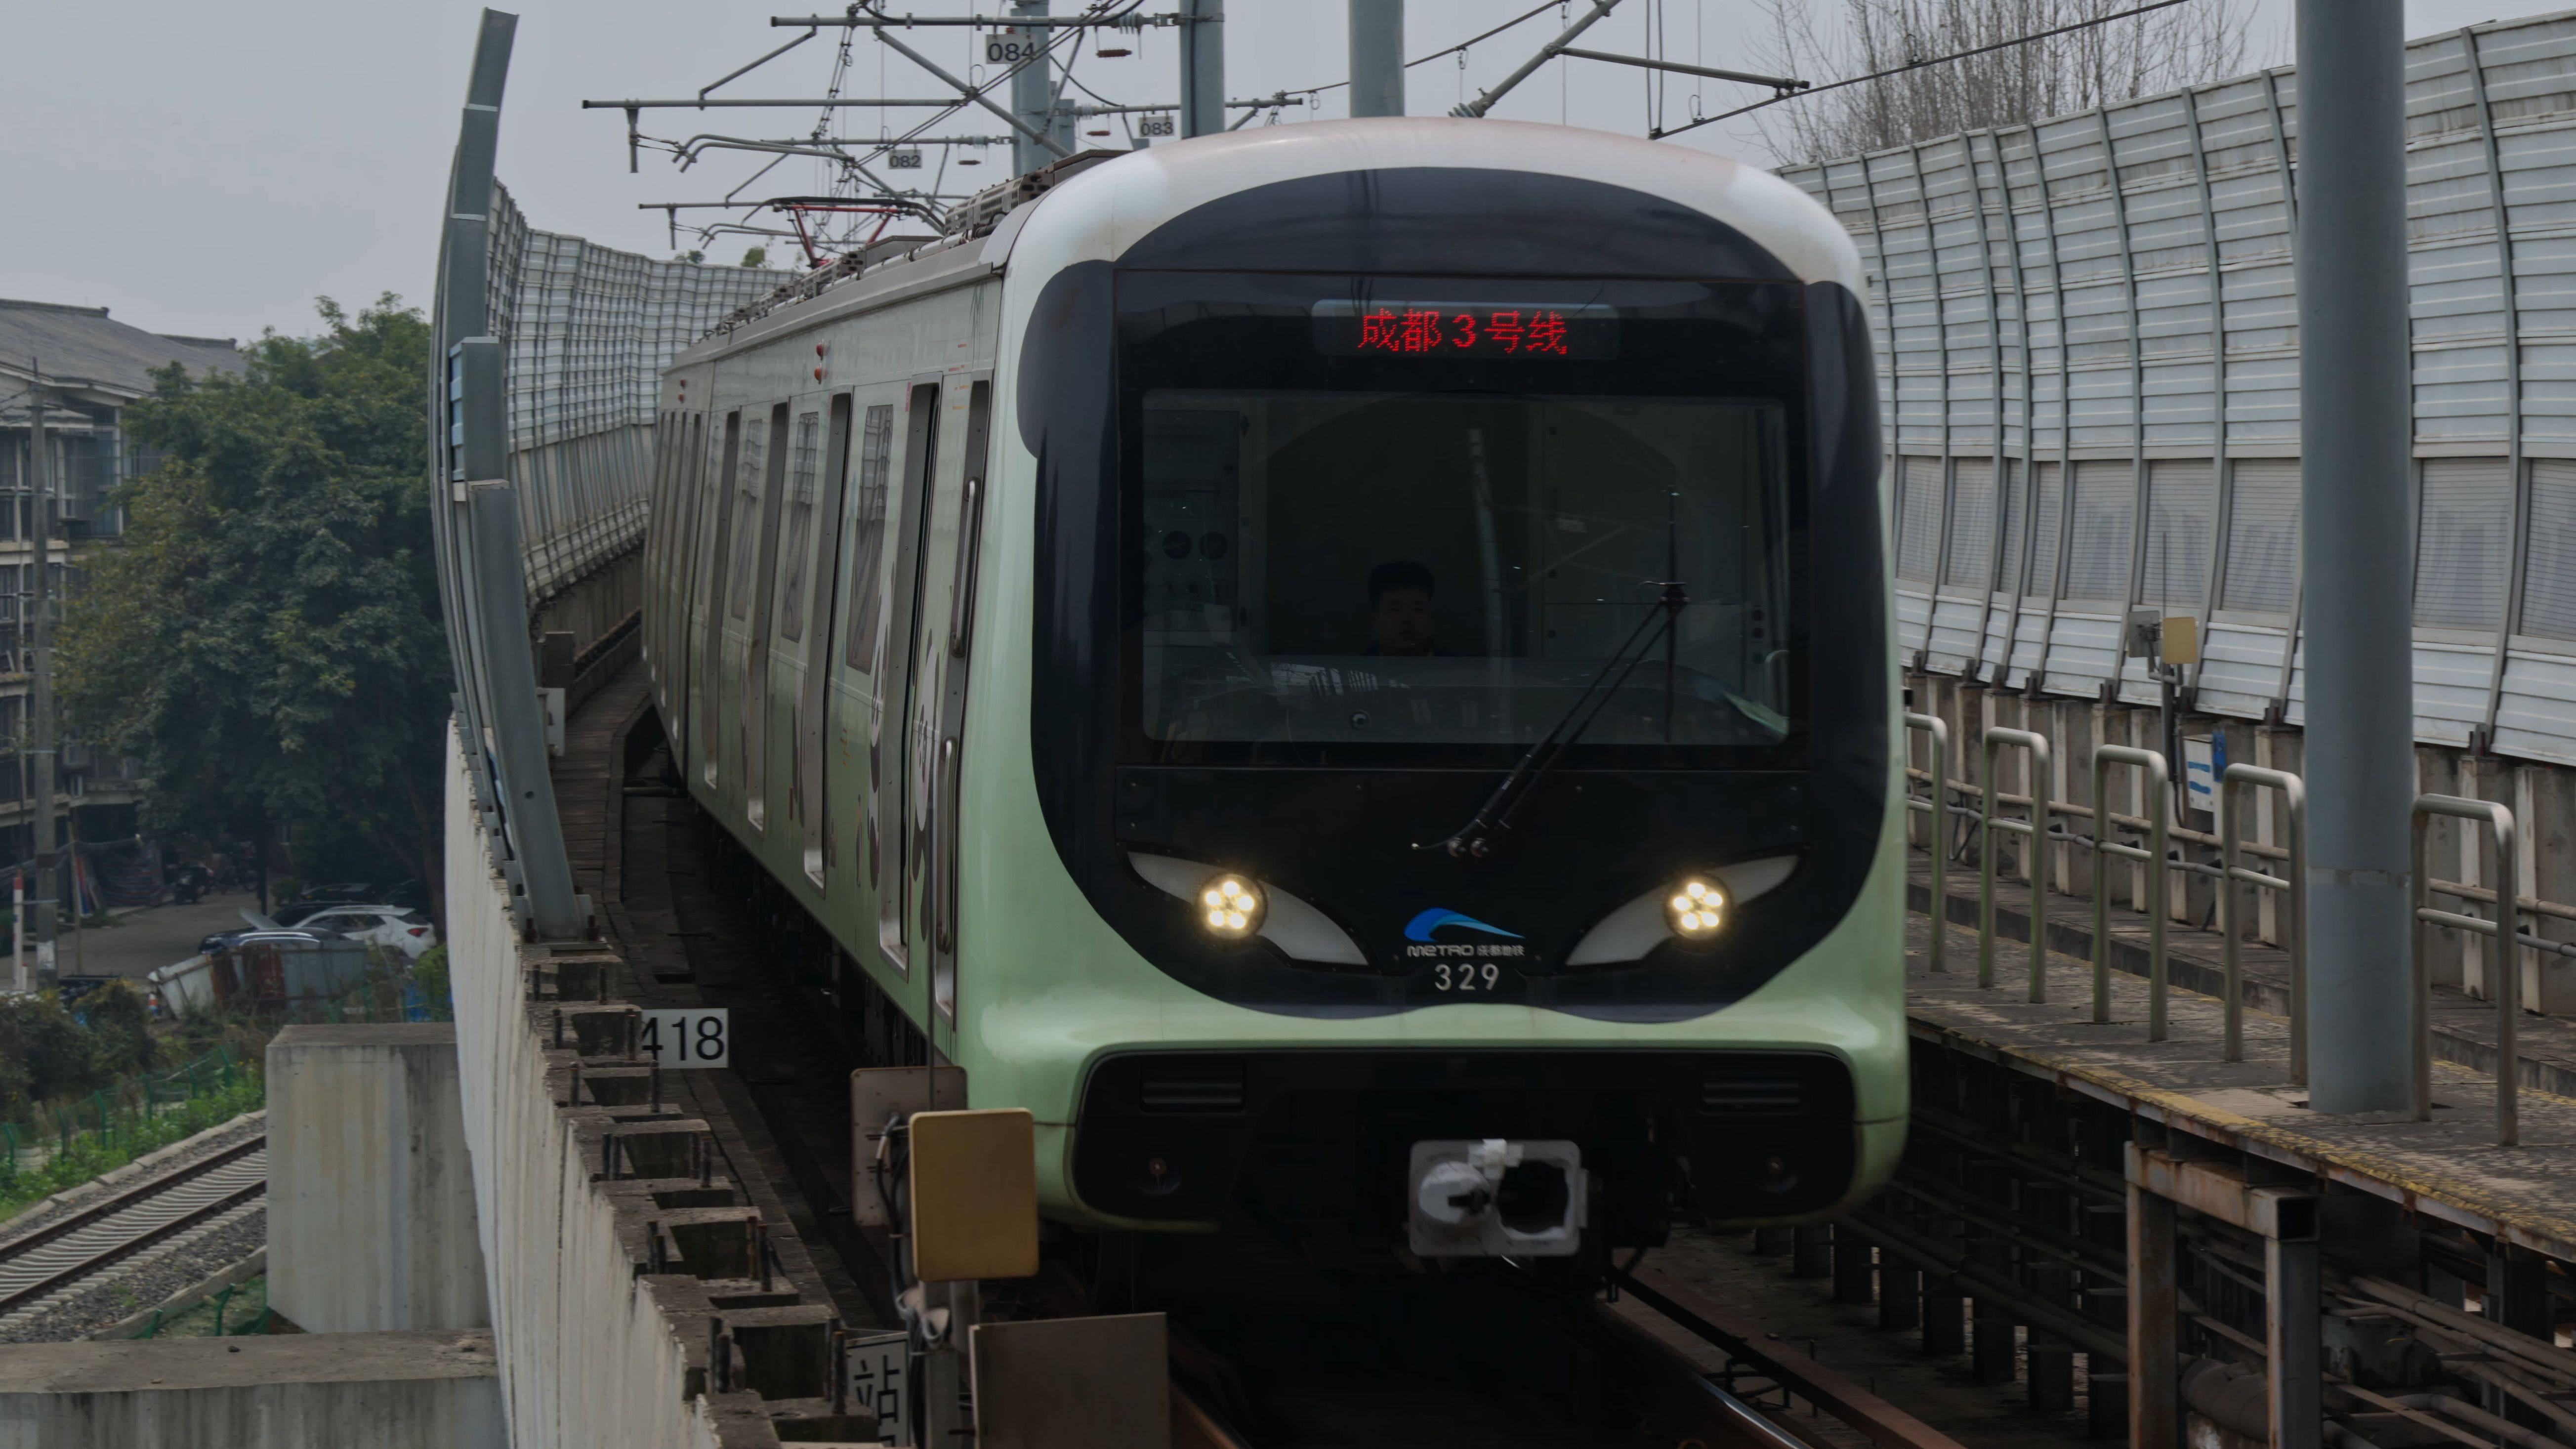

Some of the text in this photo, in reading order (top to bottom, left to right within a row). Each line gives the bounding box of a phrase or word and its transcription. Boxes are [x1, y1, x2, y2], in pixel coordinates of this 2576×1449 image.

[988, 42, 1037, 61] 084
[1140, 122, 1173, 136] 083
[889, 155, 921, 168] 082
[1407, 945, 1474, 957] METRO
[1434, 963, 1499, 991] 329
[642, 1016, 724, 1061] 418
